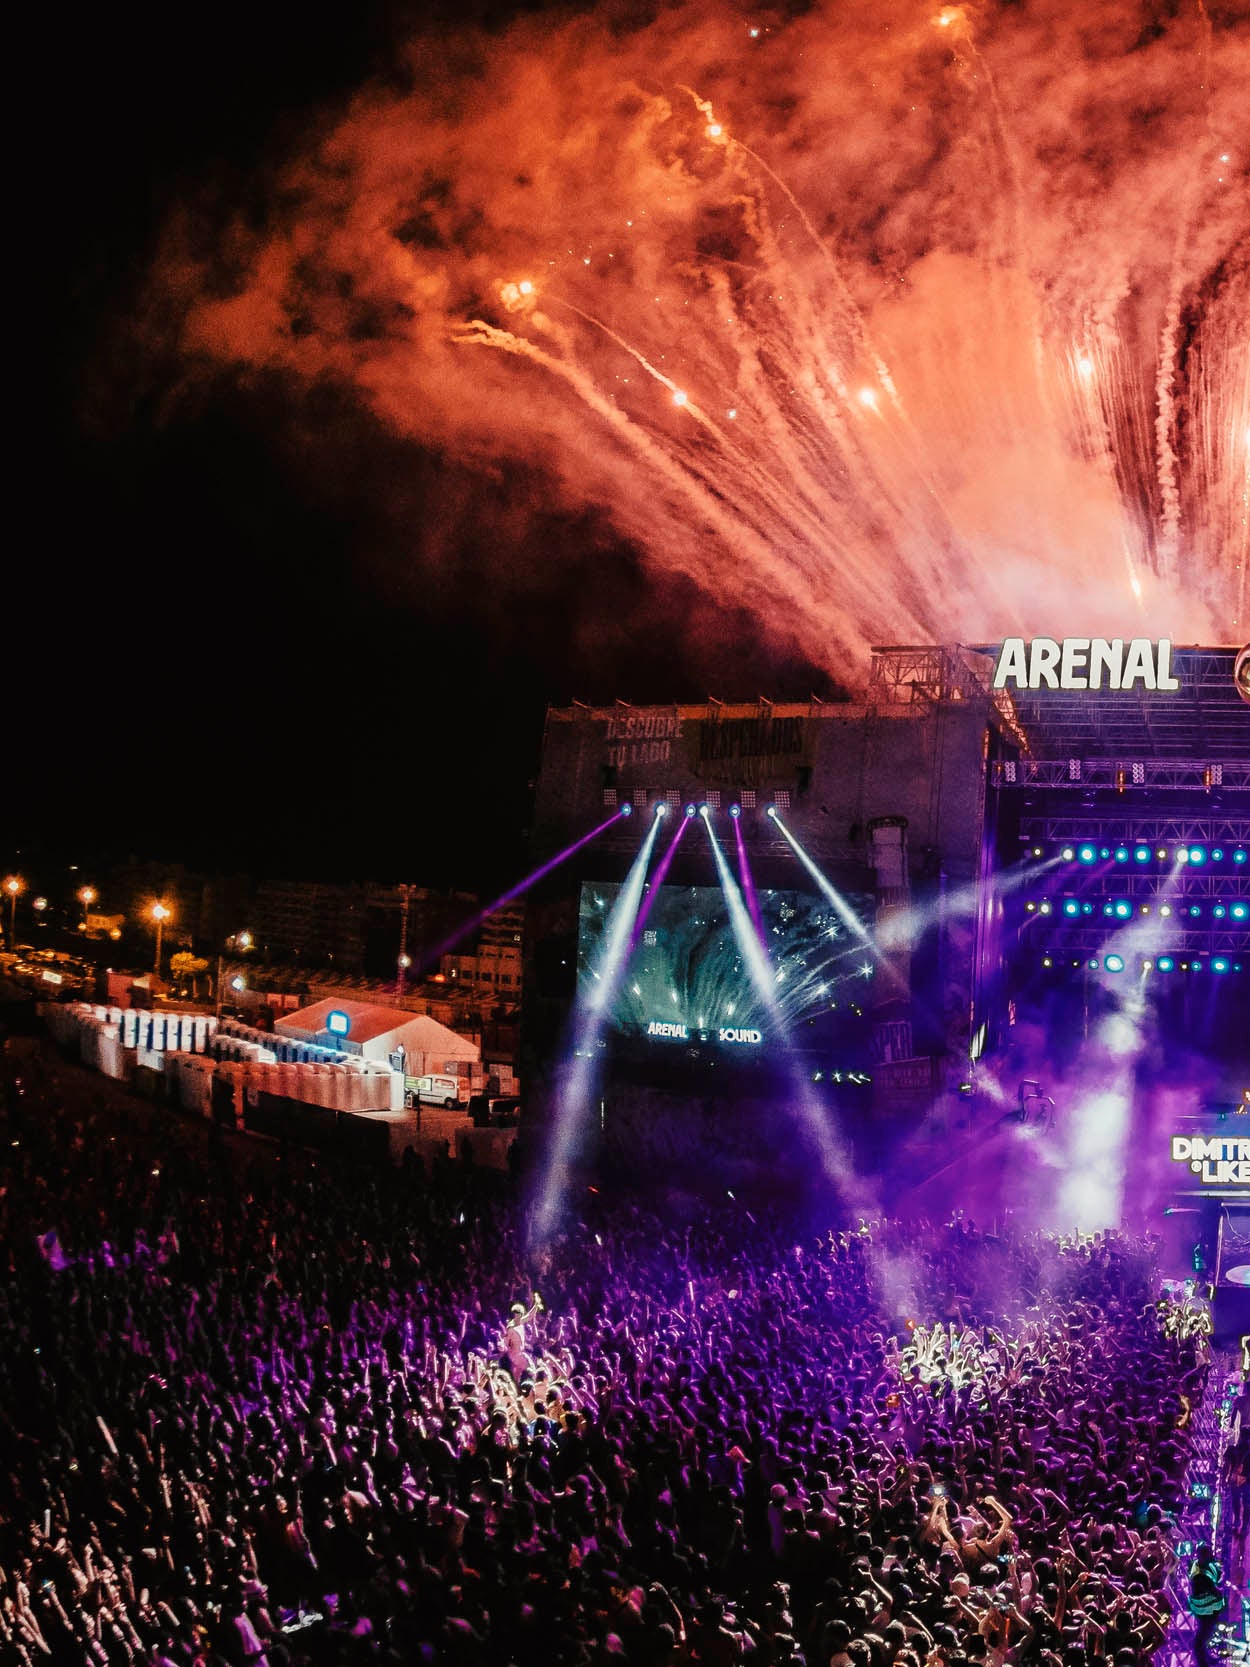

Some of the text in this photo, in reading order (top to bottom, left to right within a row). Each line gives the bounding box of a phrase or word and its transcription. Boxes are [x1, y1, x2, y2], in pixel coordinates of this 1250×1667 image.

[993, 638, 1179, 691] ARENAL
[648, 1022, 761, 1043] ARENAL SOUND
